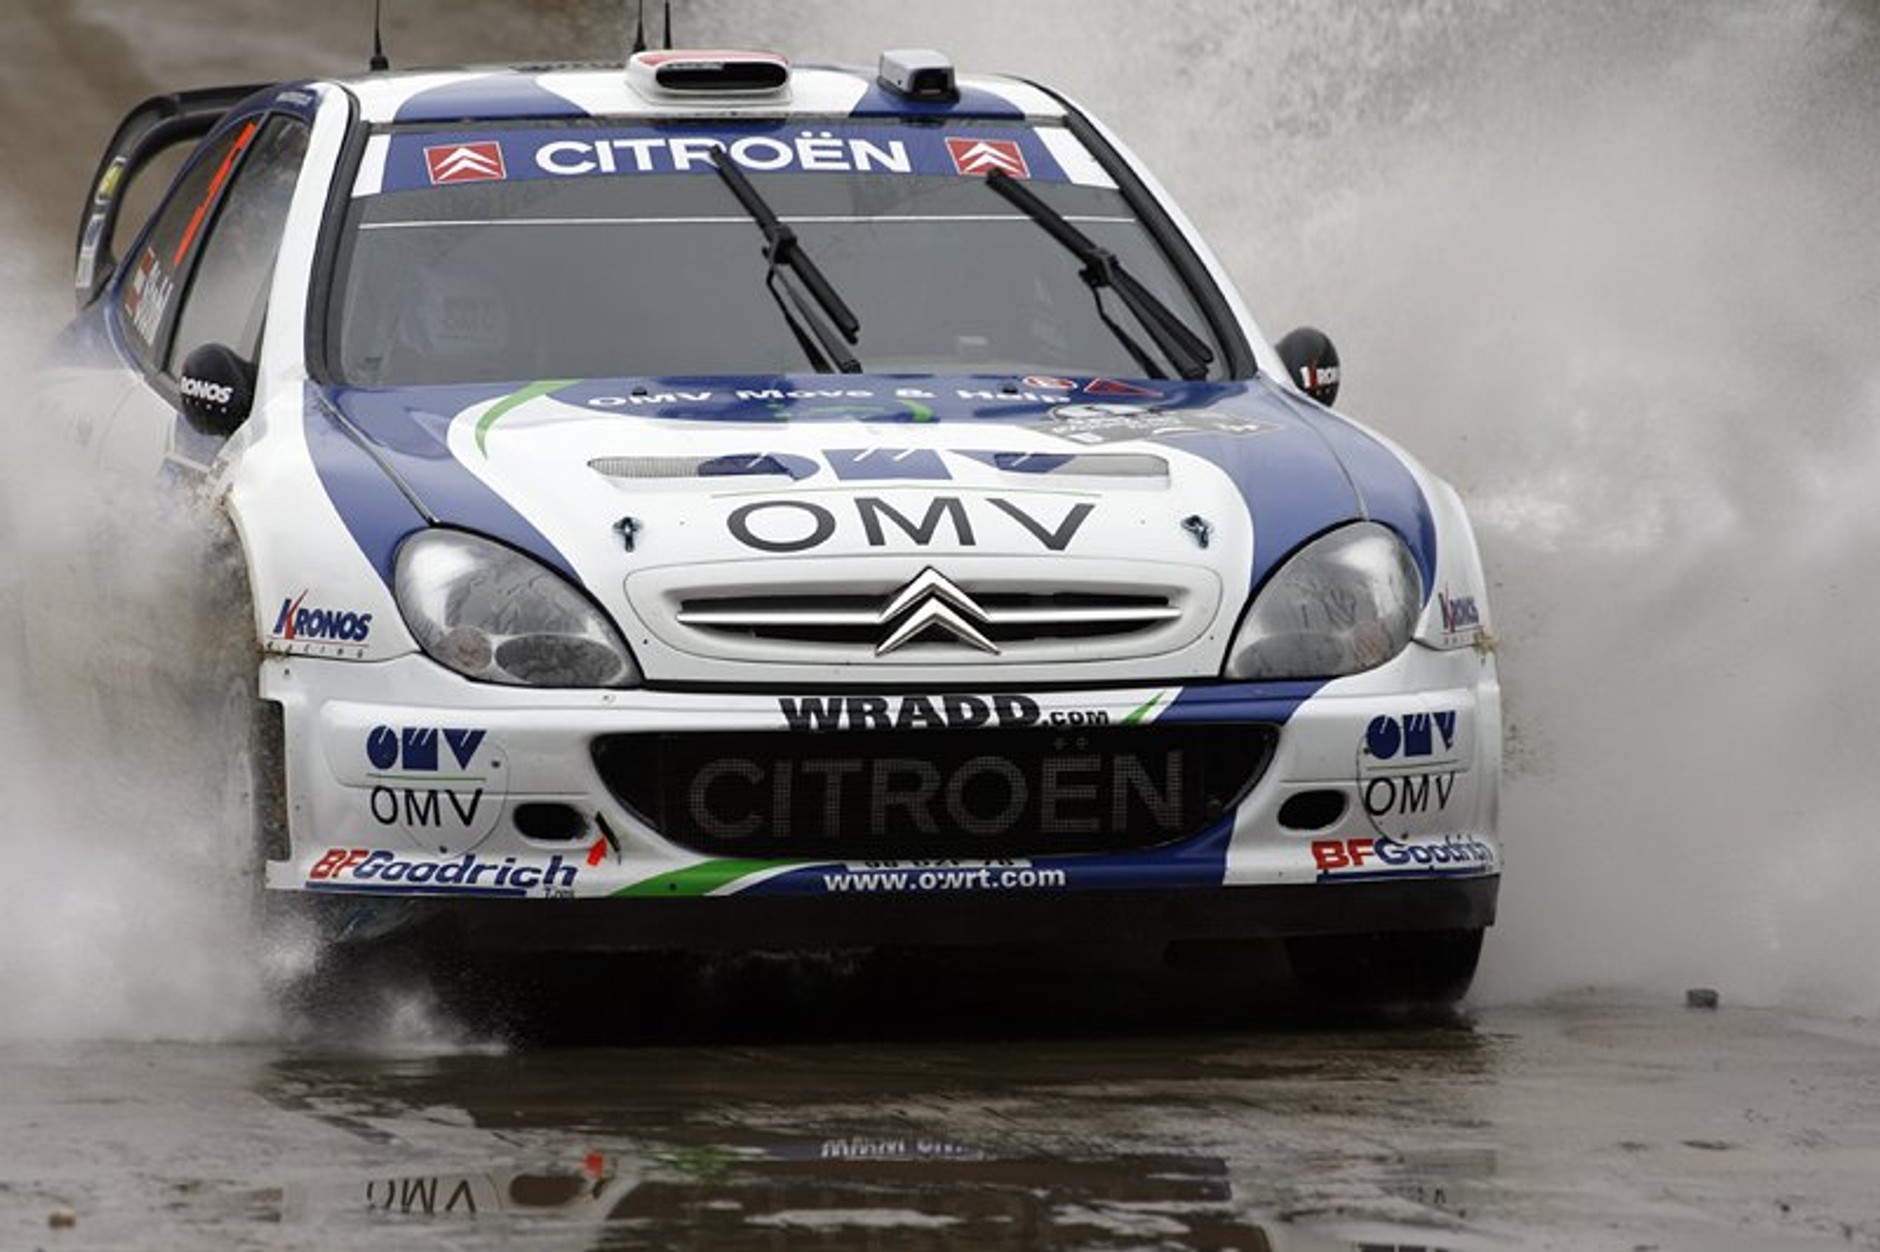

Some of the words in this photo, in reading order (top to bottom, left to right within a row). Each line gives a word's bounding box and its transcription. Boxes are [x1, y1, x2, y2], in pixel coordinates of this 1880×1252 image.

[535, 131, 912, 175] CITROËN
[588, 390, 711, 406] OMV
[736, 389, 873, 399] Move
[726, 497, 1096, 552] OMV
[273, 588, 373, 642] KRONOS
[367, 725, 487, 771] OMV
[1366, 711, 1456, 760] OMV
[371, 785, 484, 827] OMV
[690, 737, 1183, 837] CITROËN
[1365, 771, 1454, 817] OMV
[309, 849, 578, 888] BFGoodrich
